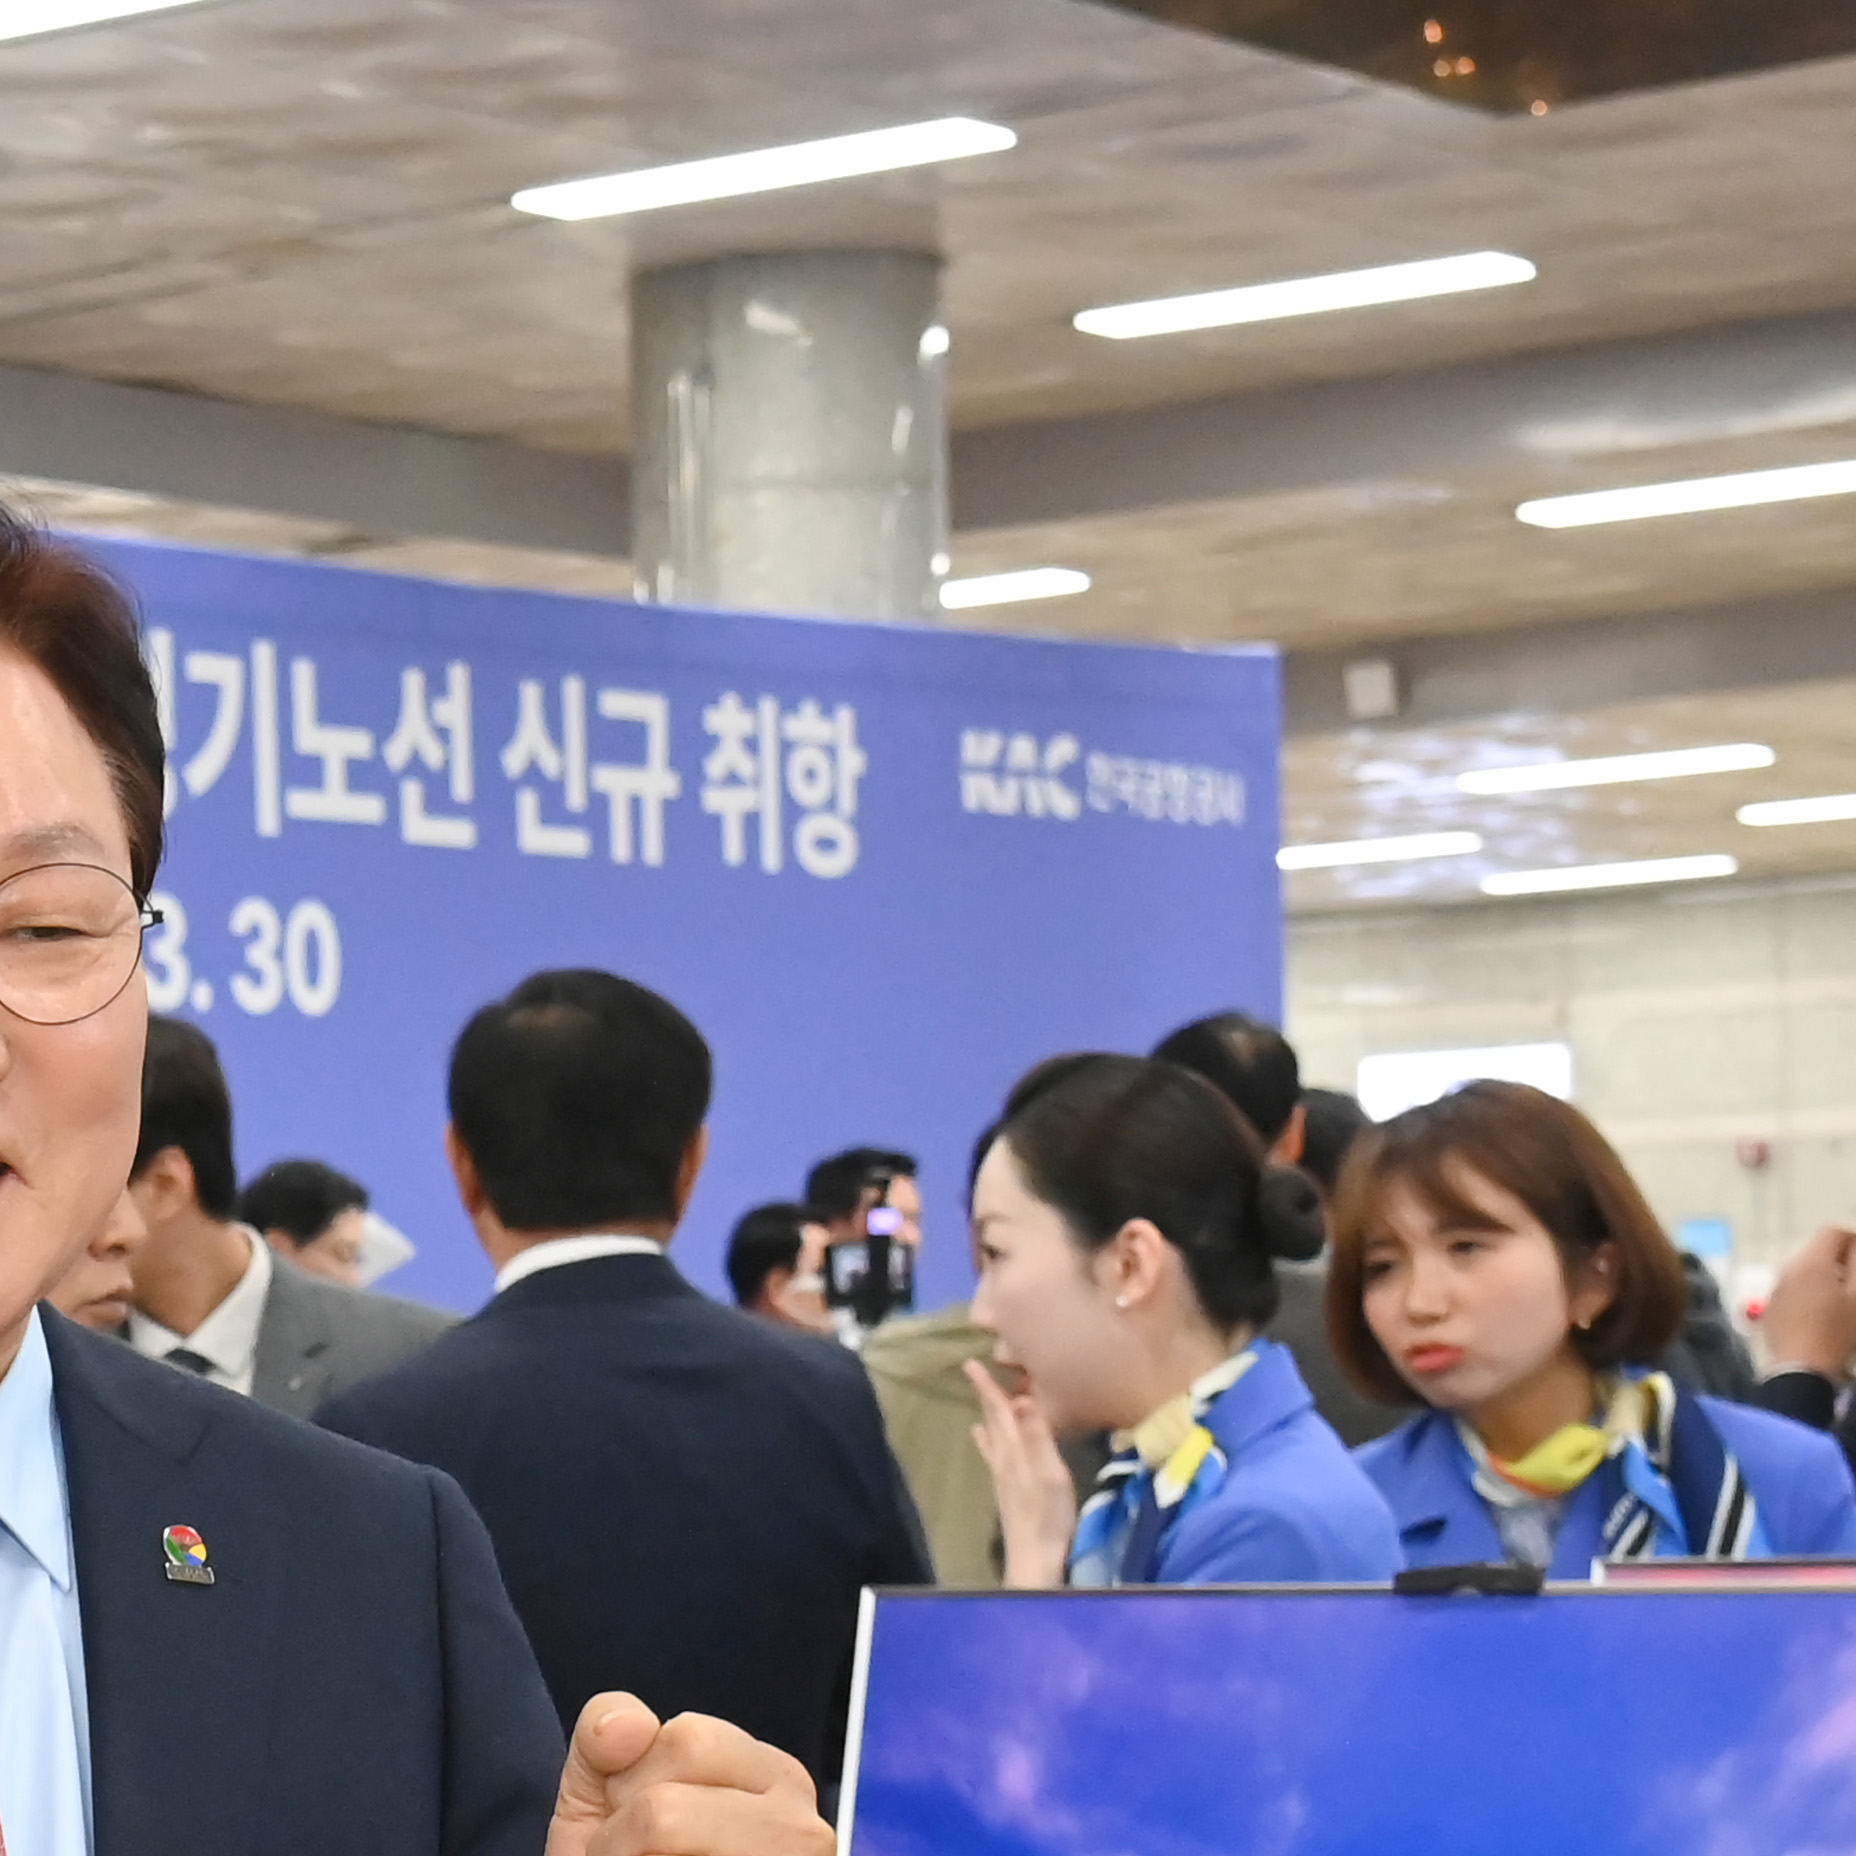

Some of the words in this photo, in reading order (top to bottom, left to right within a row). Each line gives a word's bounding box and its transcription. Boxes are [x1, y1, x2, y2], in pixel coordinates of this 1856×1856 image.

[149, 626, 478, 849] 기노선
[499, 673, 683, 868] 신규
[701, 689, 868, 879] 취항
[960, 730, 1081, 821] KAC
[228, 896, 342, 1018] 30
